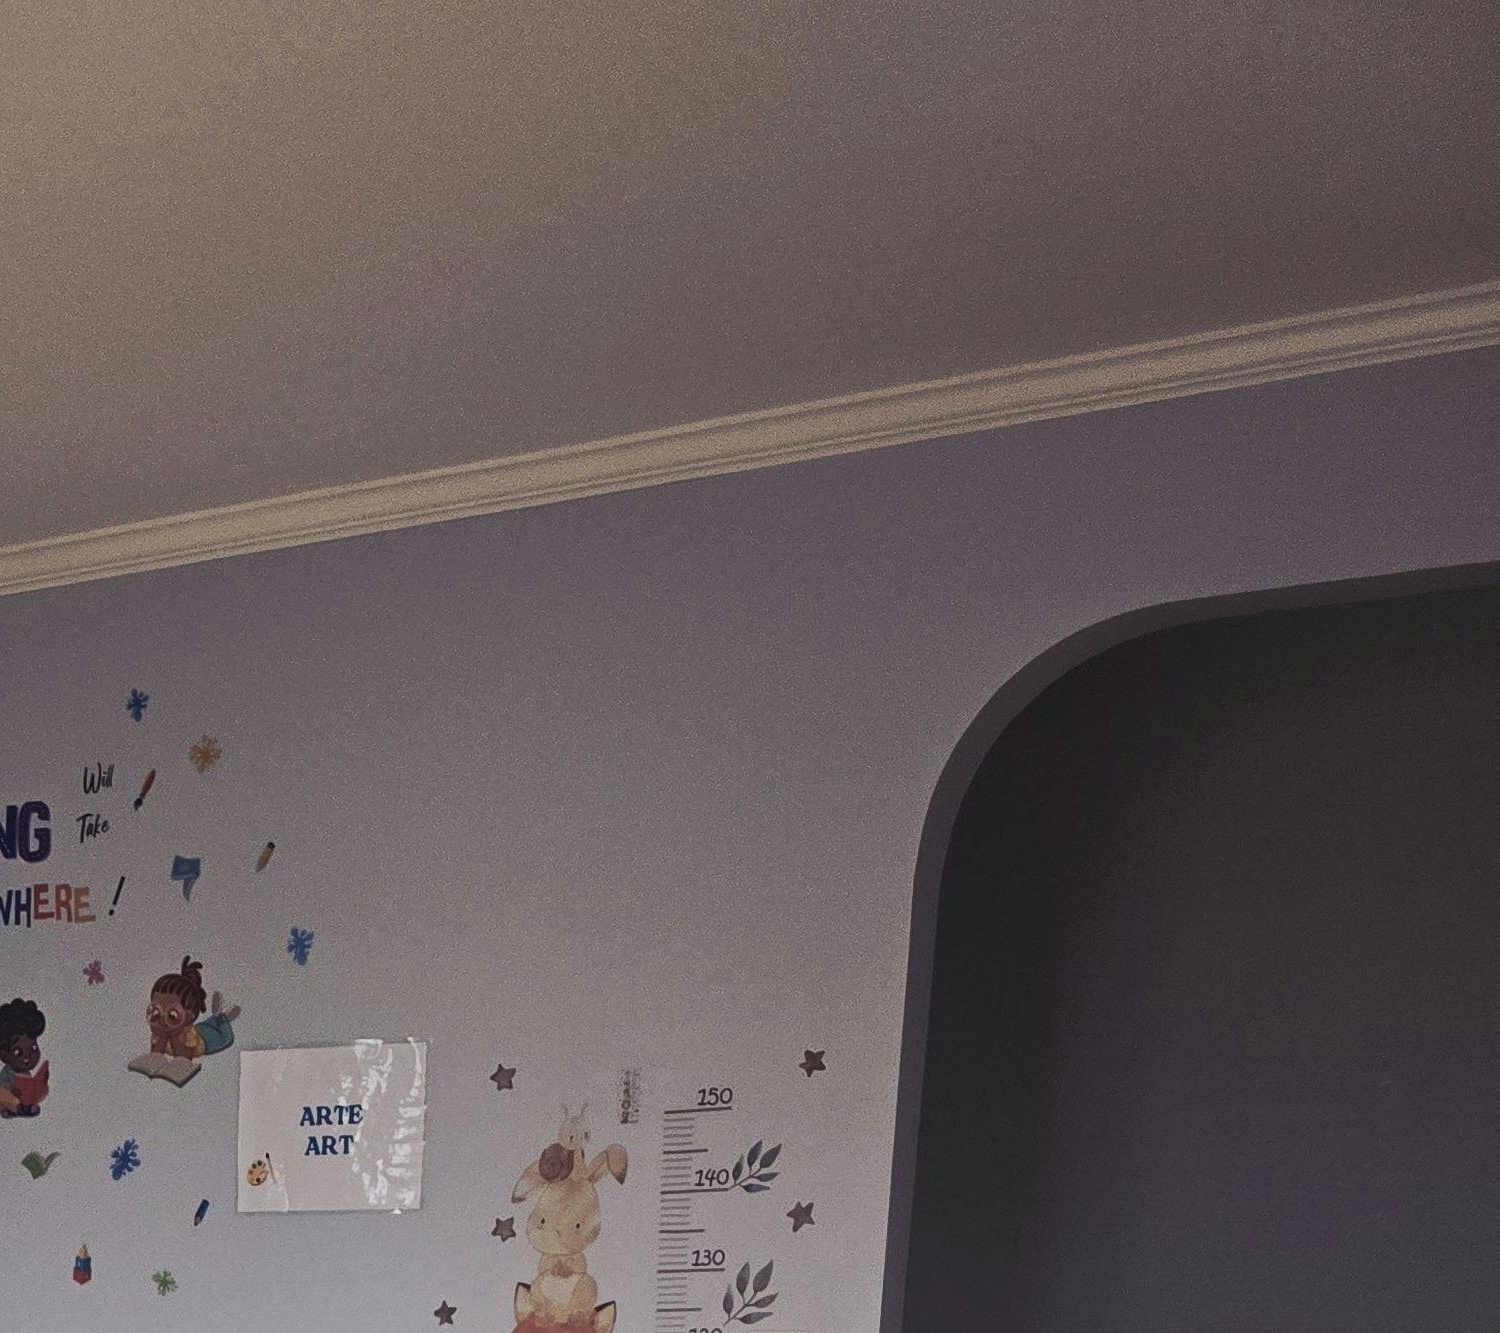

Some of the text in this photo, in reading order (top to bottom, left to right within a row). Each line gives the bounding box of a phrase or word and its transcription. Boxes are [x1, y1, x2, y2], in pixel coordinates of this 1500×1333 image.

[83, 763, 115, 794] Will
[75, 812, 110, 843] Take
[697, 1088, 734, 1106] 150
[300, 1104, 364, 1127] ARTE
[304, 1134, 355, 1156] ART
[694, 1168, 730, 1187] 140
[691, 1249, 726, 1267] 130
